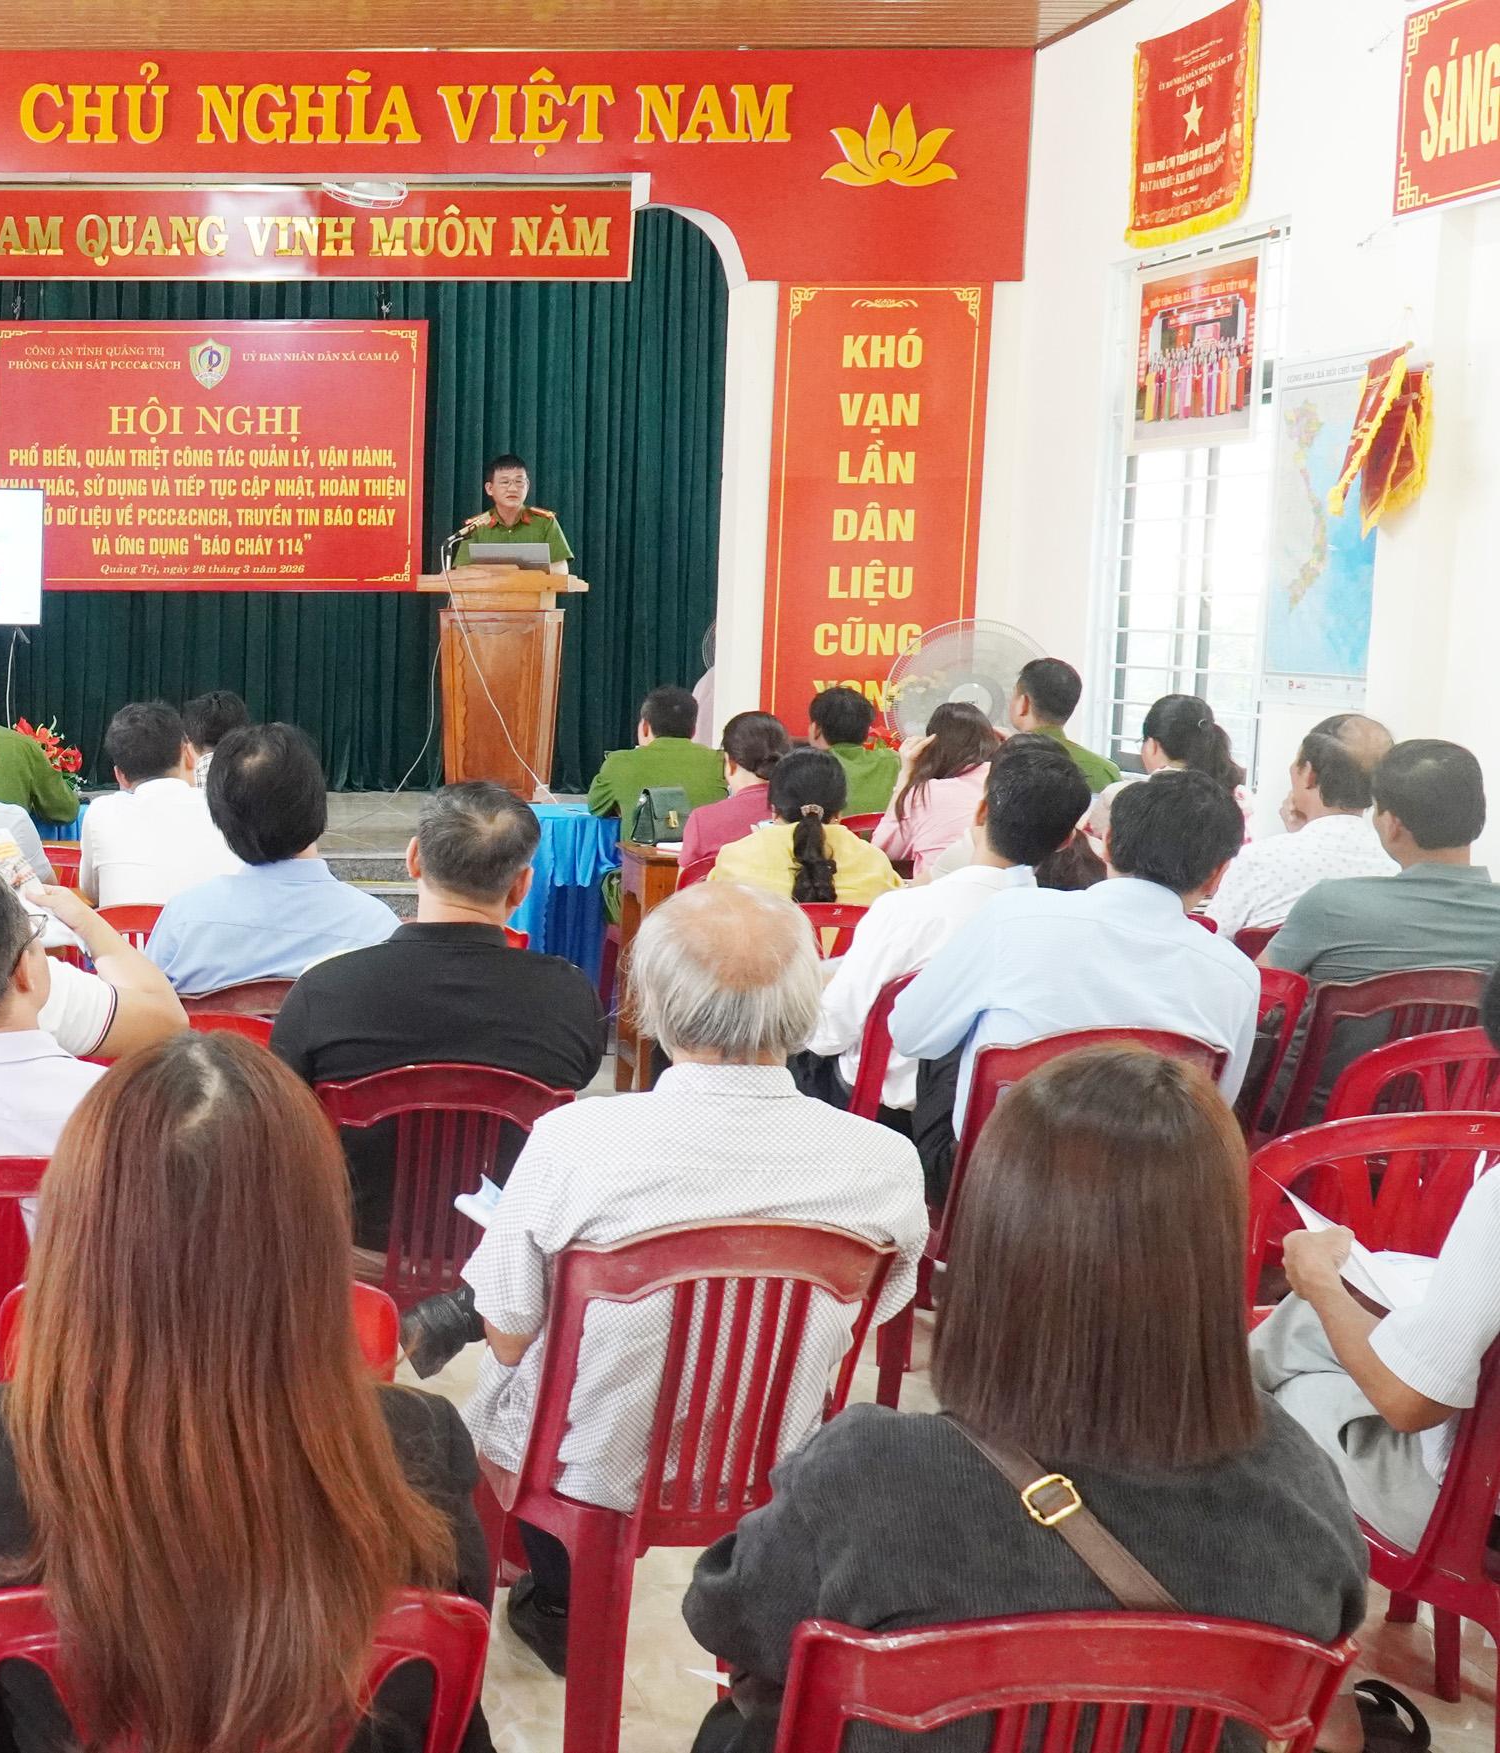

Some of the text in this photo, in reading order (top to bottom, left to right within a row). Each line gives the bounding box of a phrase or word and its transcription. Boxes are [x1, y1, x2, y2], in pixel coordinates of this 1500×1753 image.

[20, 62, 169, 144] CHỦ
[197, 70, 420, 144] NGHĨA
[438, 66, 616, 158] VIỆT
[634, 84, 793, 143] NAM
[1420, 37, 1500, 162] SÁNG
[76, 215, 228, 266] QUANG
[244, 216, 354, 257] VINH
[369, 205, 496, 257] MUÔN
[511, 203, 611, 256] NĂM
[842, 328, 922, 368] KHÓ
[108, 397, 302, 443] HỘI NGHỊ
[840, 393, 919, 433] VẠN
[9, 442, 396, 470] PHỔ BIẾN, QUÁN TRIỆT CÔNG TÁC QUẢN LÝ, VẬN HÀNH,
[837, 440, 915, 484] LẦN
[38, 476, 79, 497] THÁC,
[84, 473, 104, 496] SỬ
[108, 479, 147, 499] DỤNG
[152, 476, 170, 496] VÀ
[174, 473, 205, 496] TIẾP
[210, 479, 237, 499] TỤC
[242, 476, 270, 499] CẬP
[275, 476, 315, 499] NHẬT,
[320, 476, 359, 496] HOÀN
[364, 476, 405, 499] THIỆN
[57, 505, 78, 525] DỮ
[81, 505, 111, 529] LIỆU
[116, 503, 133, 525] VỀ
[138, 508, 232, 527] PCCC&CNCH,
[236, 503, 291, 526] TRUYỀN
[297, 509, 319, 525] TIN
[324, 505, 353, 526] BÁO
[357, 505, 396, 525] CHÁY
[833, 502, 915, 542] DÂN
[92, 534, 110, 555] VÀ
[115, 535, 144, 555] ỨNG
[149, 538, 188, 558] DỤNG
[235, 535, 272, 555] CHÁY
[829, 559, 913, 606] LIỆU
[813, 617, 923, 656] CŨNG
